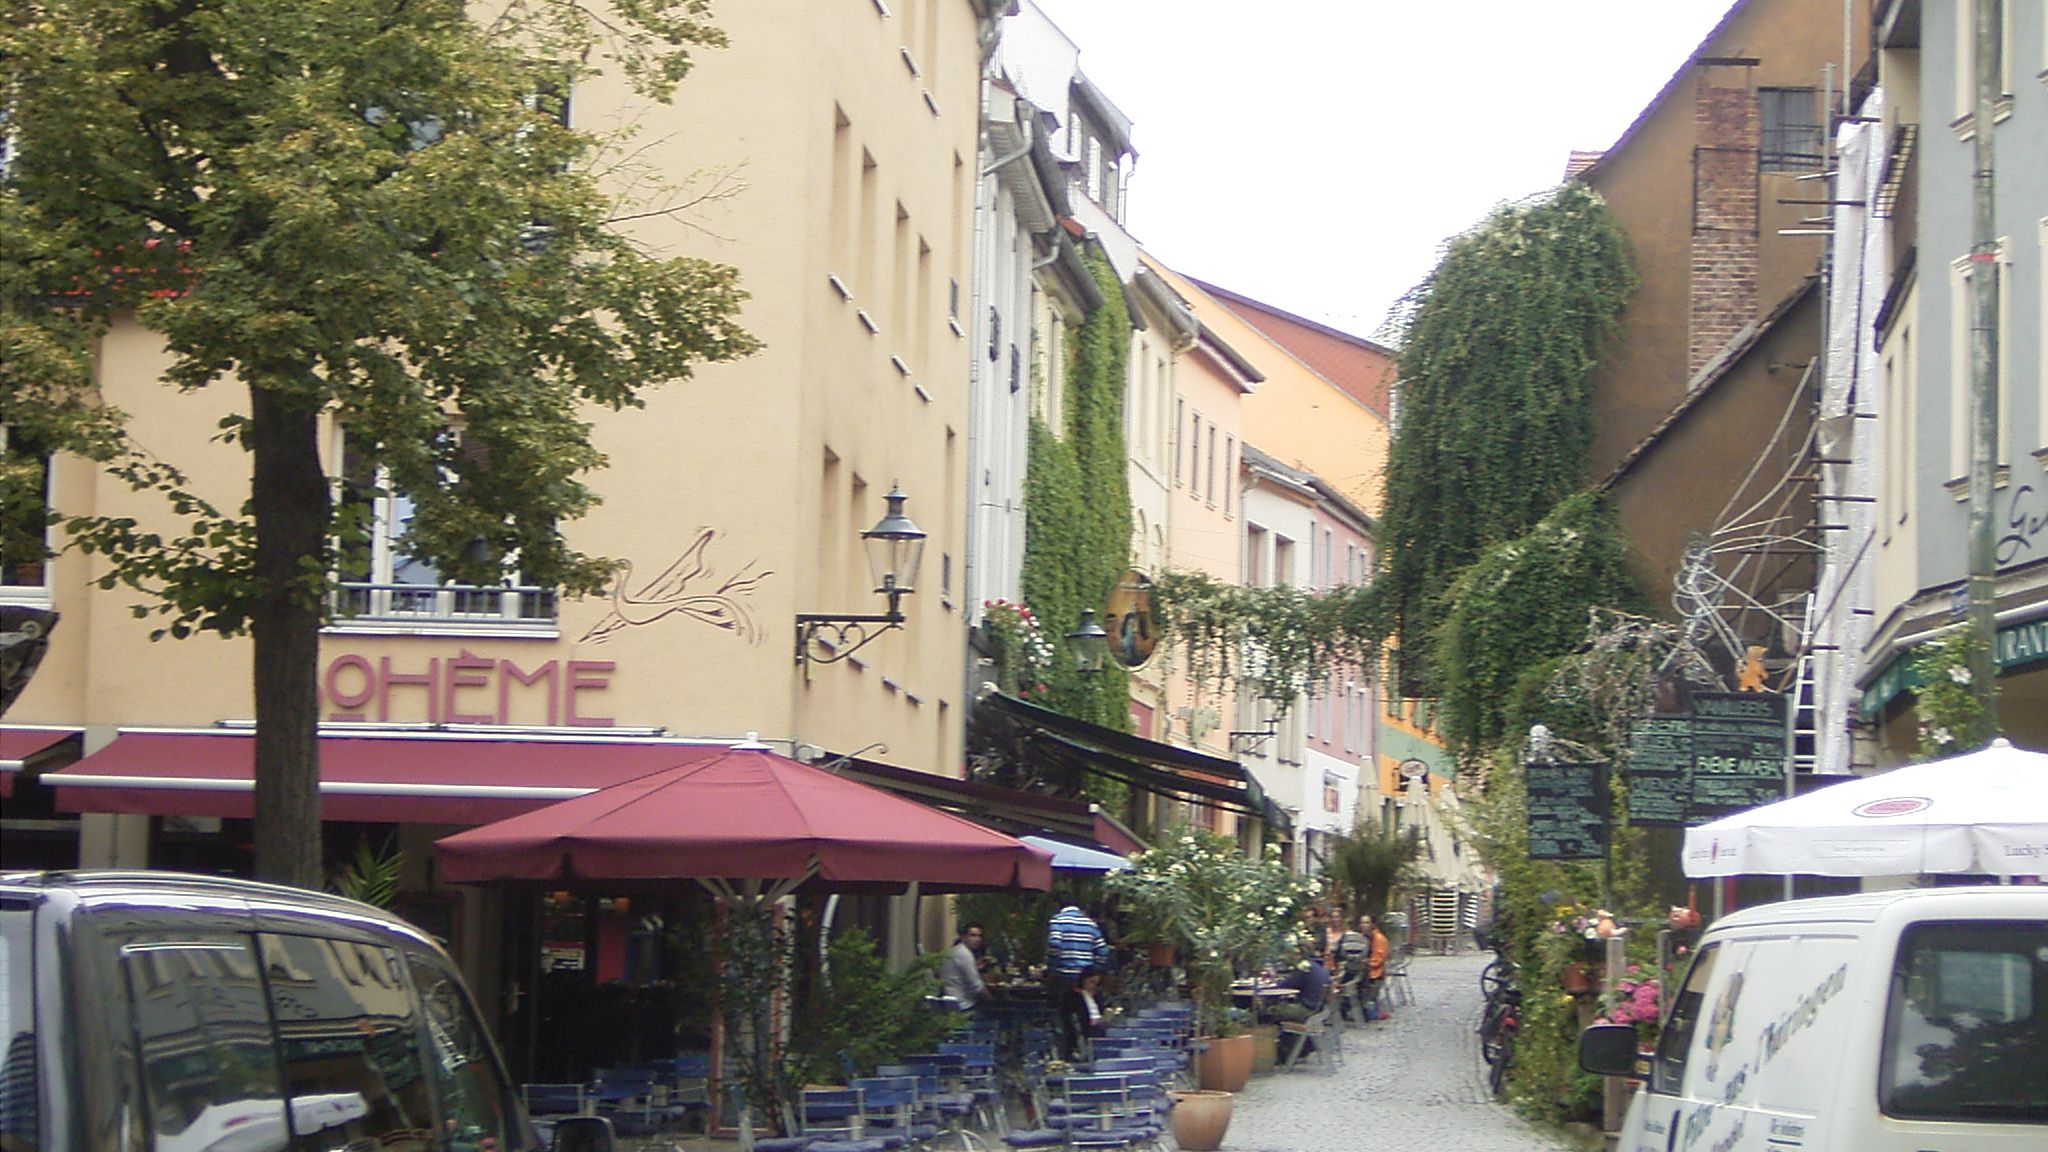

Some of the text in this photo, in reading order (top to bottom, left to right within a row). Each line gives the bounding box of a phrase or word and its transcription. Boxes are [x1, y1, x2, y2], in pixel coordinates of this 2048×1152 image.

[1994, 621, 2048, 664] RANT
[318, 649, 616, 726] OHÈME
[2004, 844, 2039, 858] Lucky
